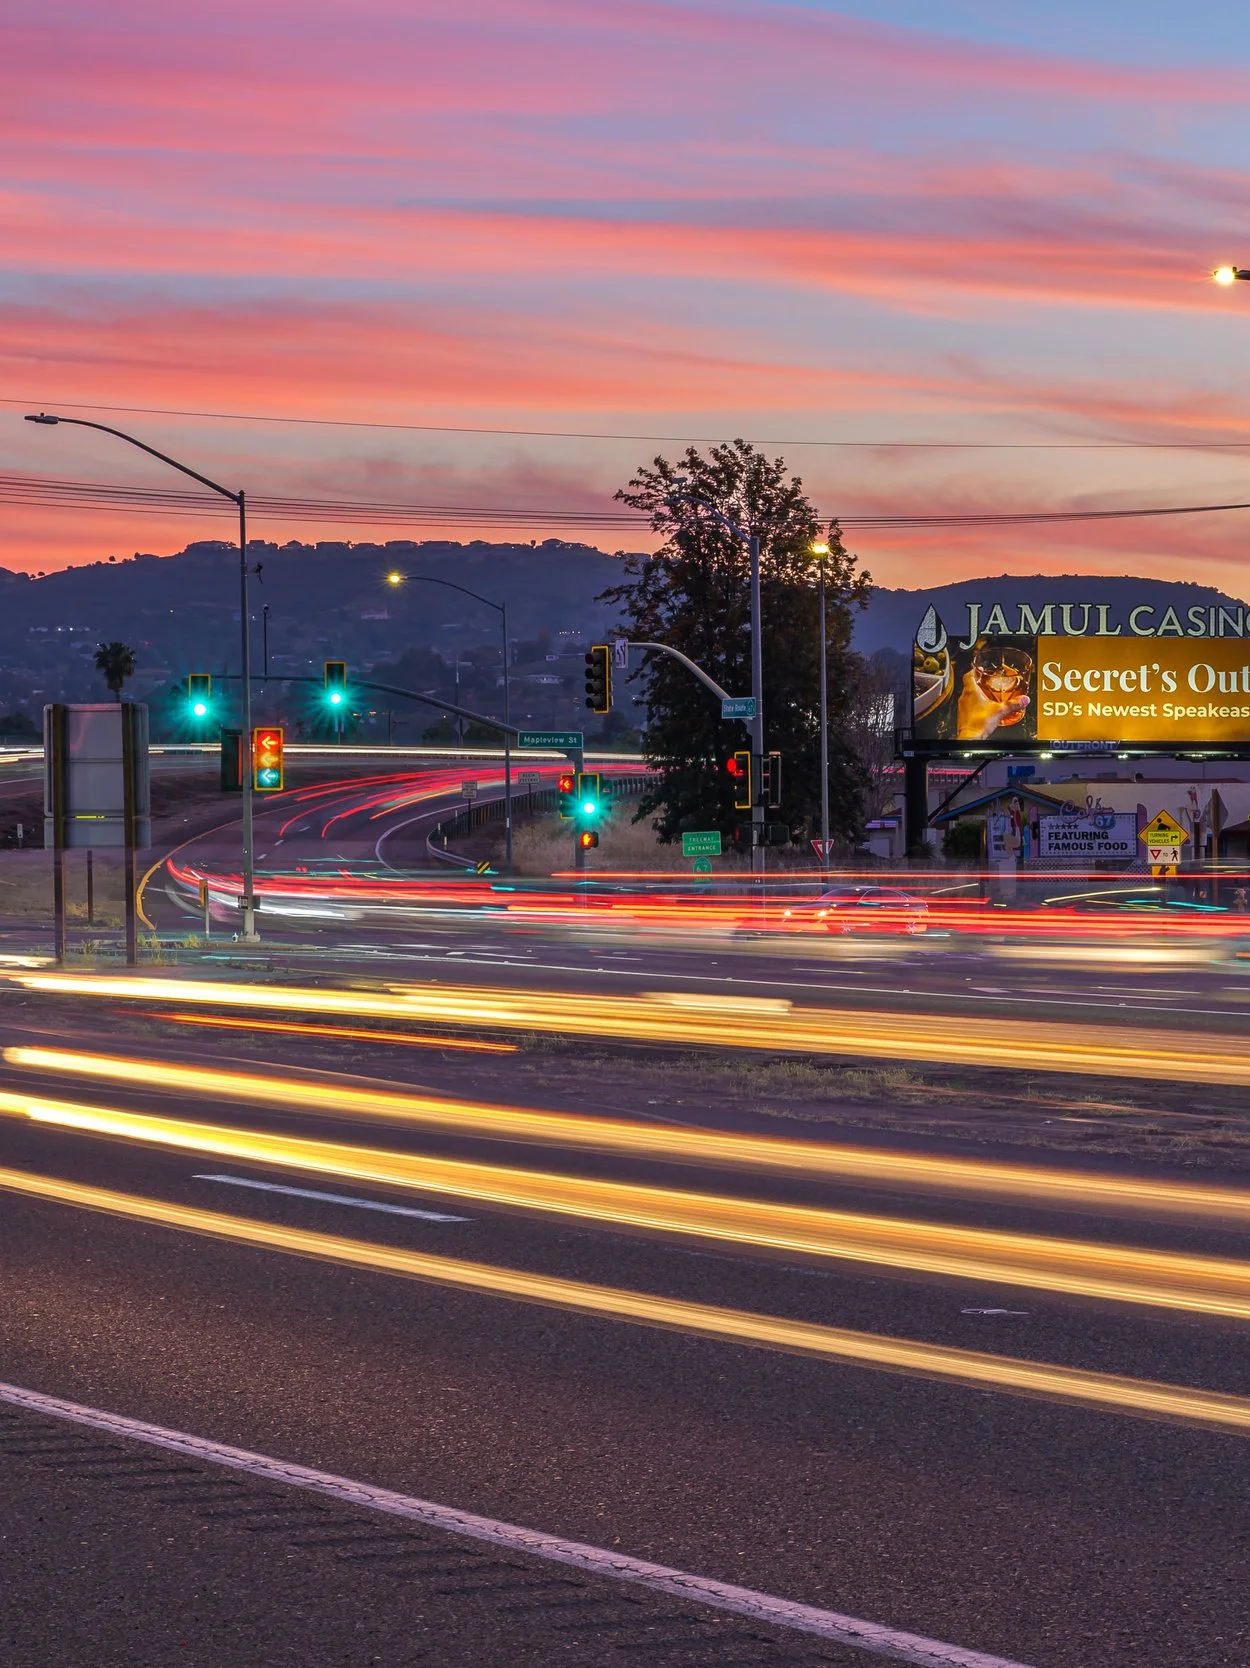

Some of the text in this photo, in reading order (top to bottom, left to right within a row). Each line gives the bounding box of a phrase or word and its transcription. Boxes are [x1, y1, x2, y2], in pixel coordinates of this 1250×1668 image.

[959, 603, 1122, 650] JAMUL
[1088, 703, 1157, 718] Newest
[523, 736, 565, 744] Mapleview
[1095, 816, 1112, 827] 67
[1048, 831, 1109, 840] FEATURING
[1048, 842, 1128, 850] FAMOUS FOOD
